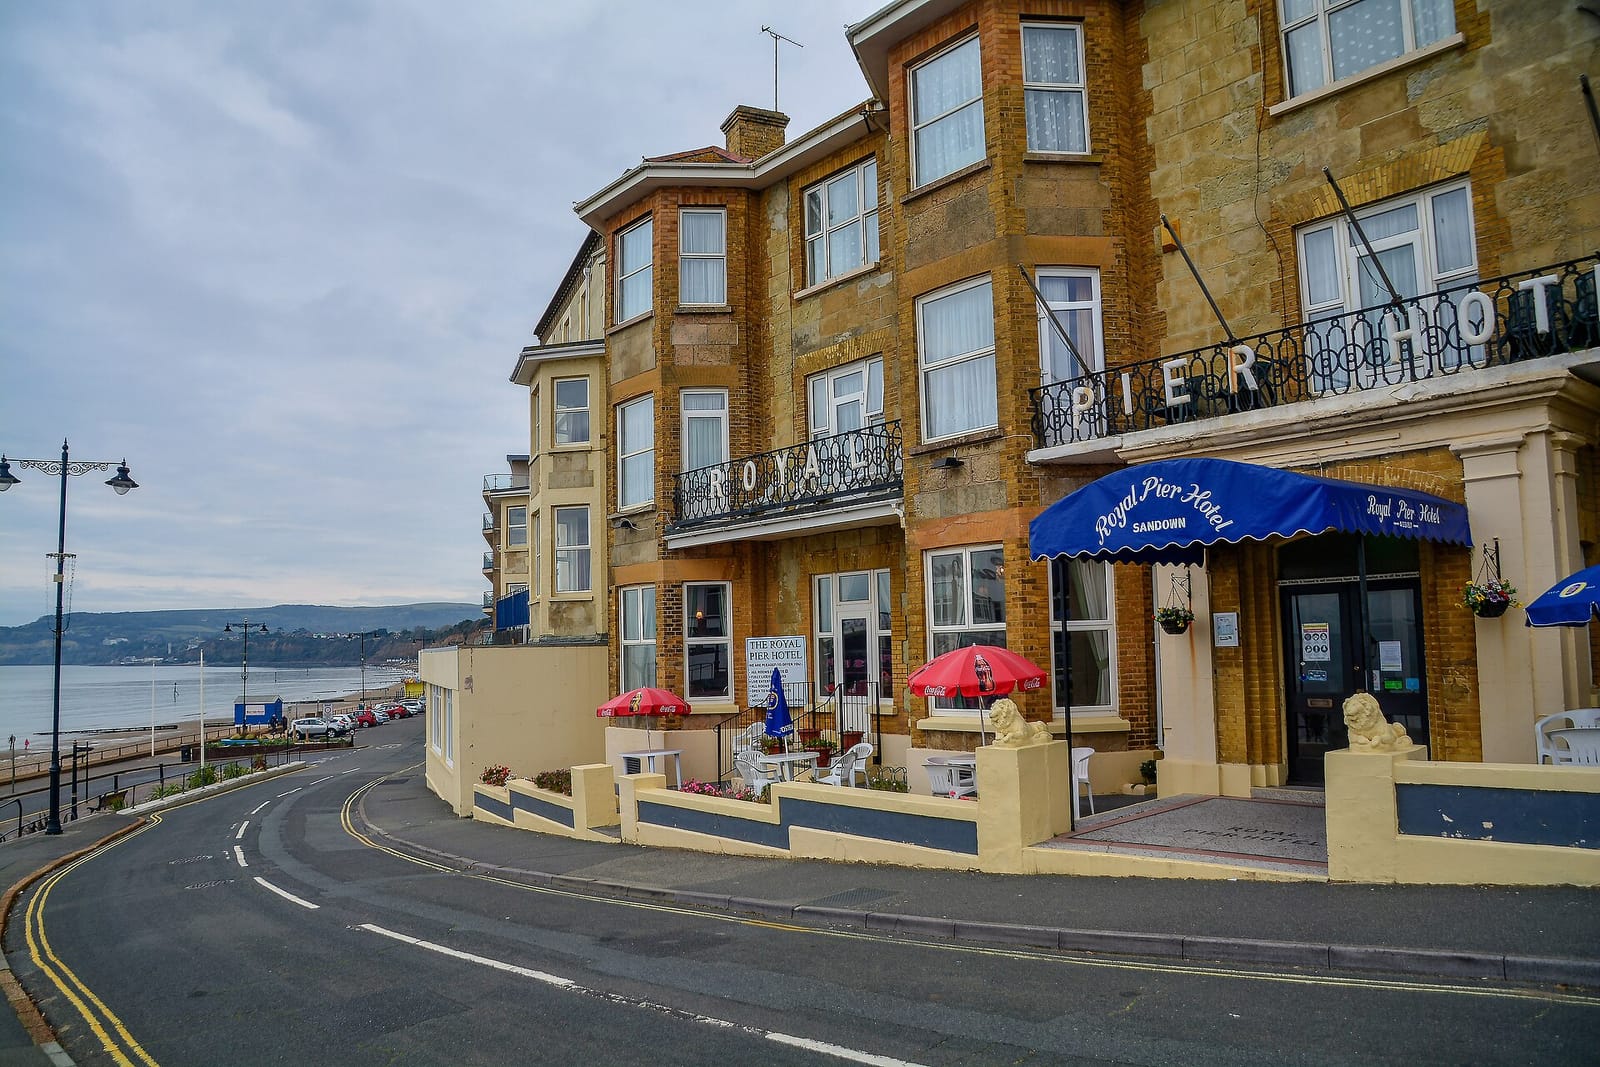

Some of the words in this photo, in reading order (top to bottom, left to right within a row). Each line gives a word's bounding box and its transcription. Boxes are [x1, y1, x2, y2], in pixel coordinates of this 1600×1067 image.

[1071, 344, 1258, 430] PIER
[1383, 264, 1600, 364] HOT
[710, 434, 868, 499] ROYAL
[1095, 484, 1138, 546] Royal
[1139, 476, 1182, 502] Pier
[1180, 483, 1234, 533] Hotel
[1367, 494, 1392, 523] Royal
[1396, 499, 1415, 520] Pier
[1418, 503, 1441, 524] Hotel
[1132, 517, 1187, 533] SANDOWN
[749, 641, 768, 650] THE
[769, 639, 802, 649] ROYAL
[749, 652, 770, 661] PIER
[771, 650, 803, 660] HOTEL
[1183, 828, 1238, 838] PIER
[1243, 835, 1320, 846] HOTEL
[1227, 826, 1298, 838] ROYAL
